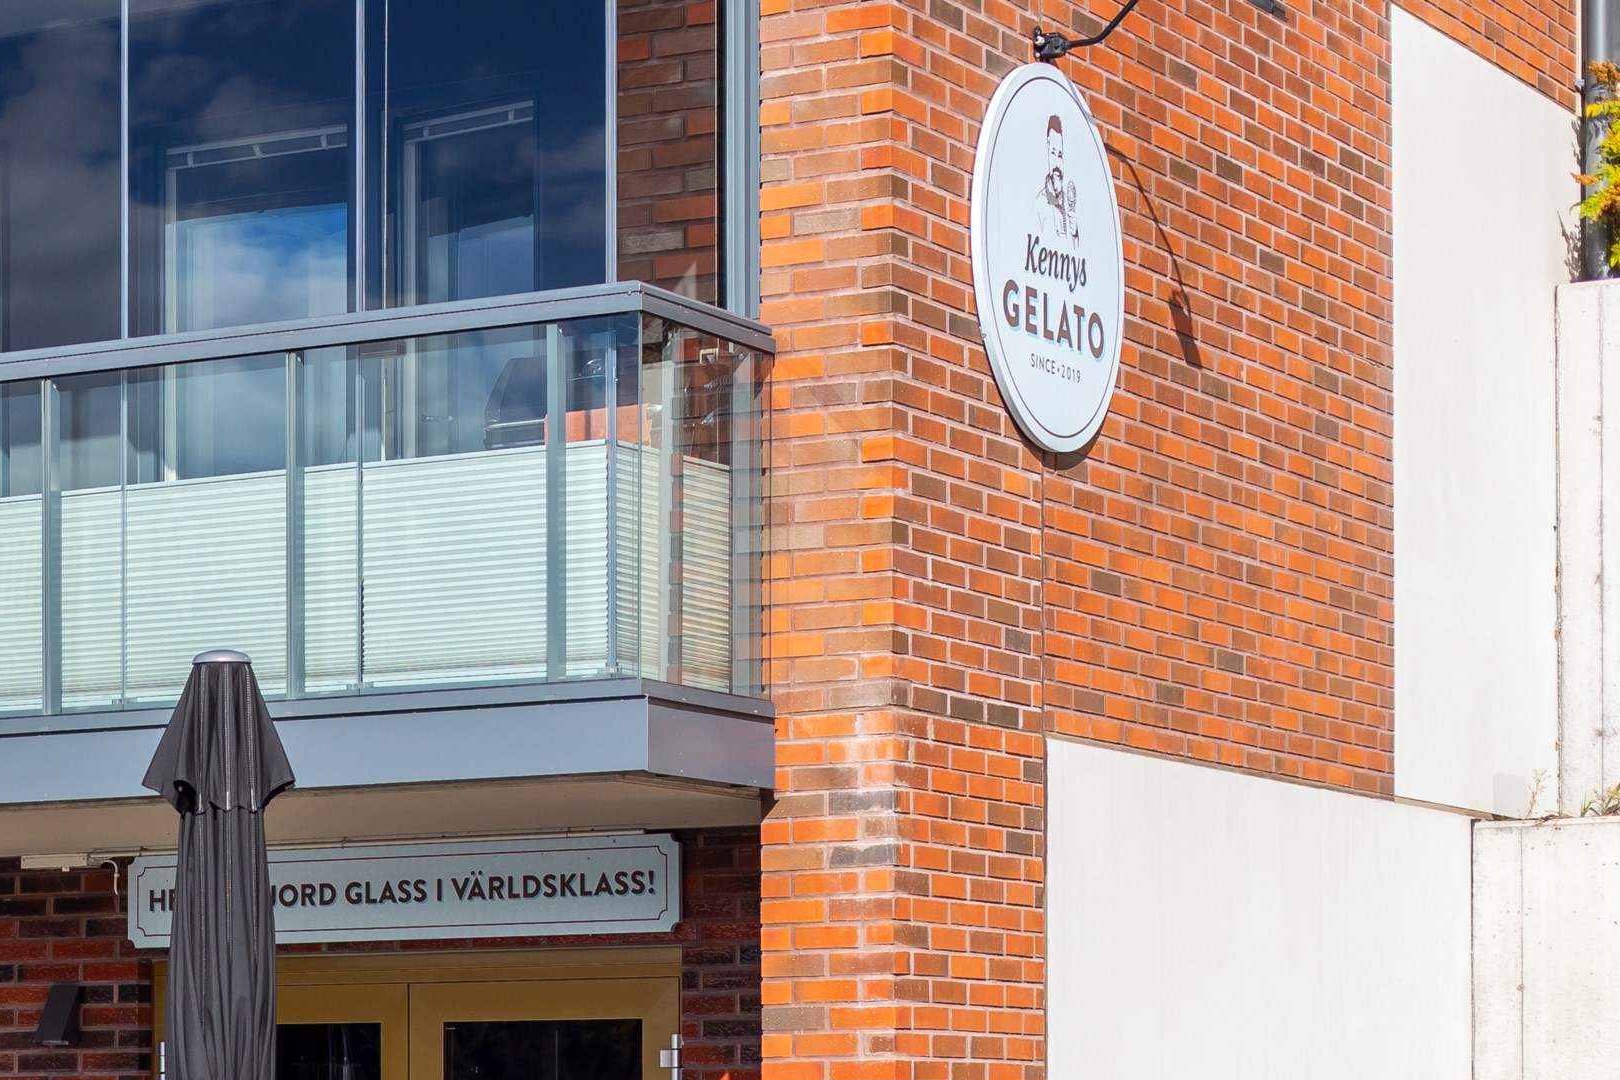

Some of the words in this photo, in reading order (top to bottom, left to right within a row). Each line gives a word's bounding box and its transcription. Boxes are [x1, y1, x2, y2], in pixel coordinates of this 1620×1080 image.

[1025, 233, 1087, 293] Kennys
[1002, 279, 1105, 360] GELATO
[344, 878, 428, 905] GLASS
[436, 878, 443, 902] I
[451, 869, 656, 901] VÄRLDSKLASS!
